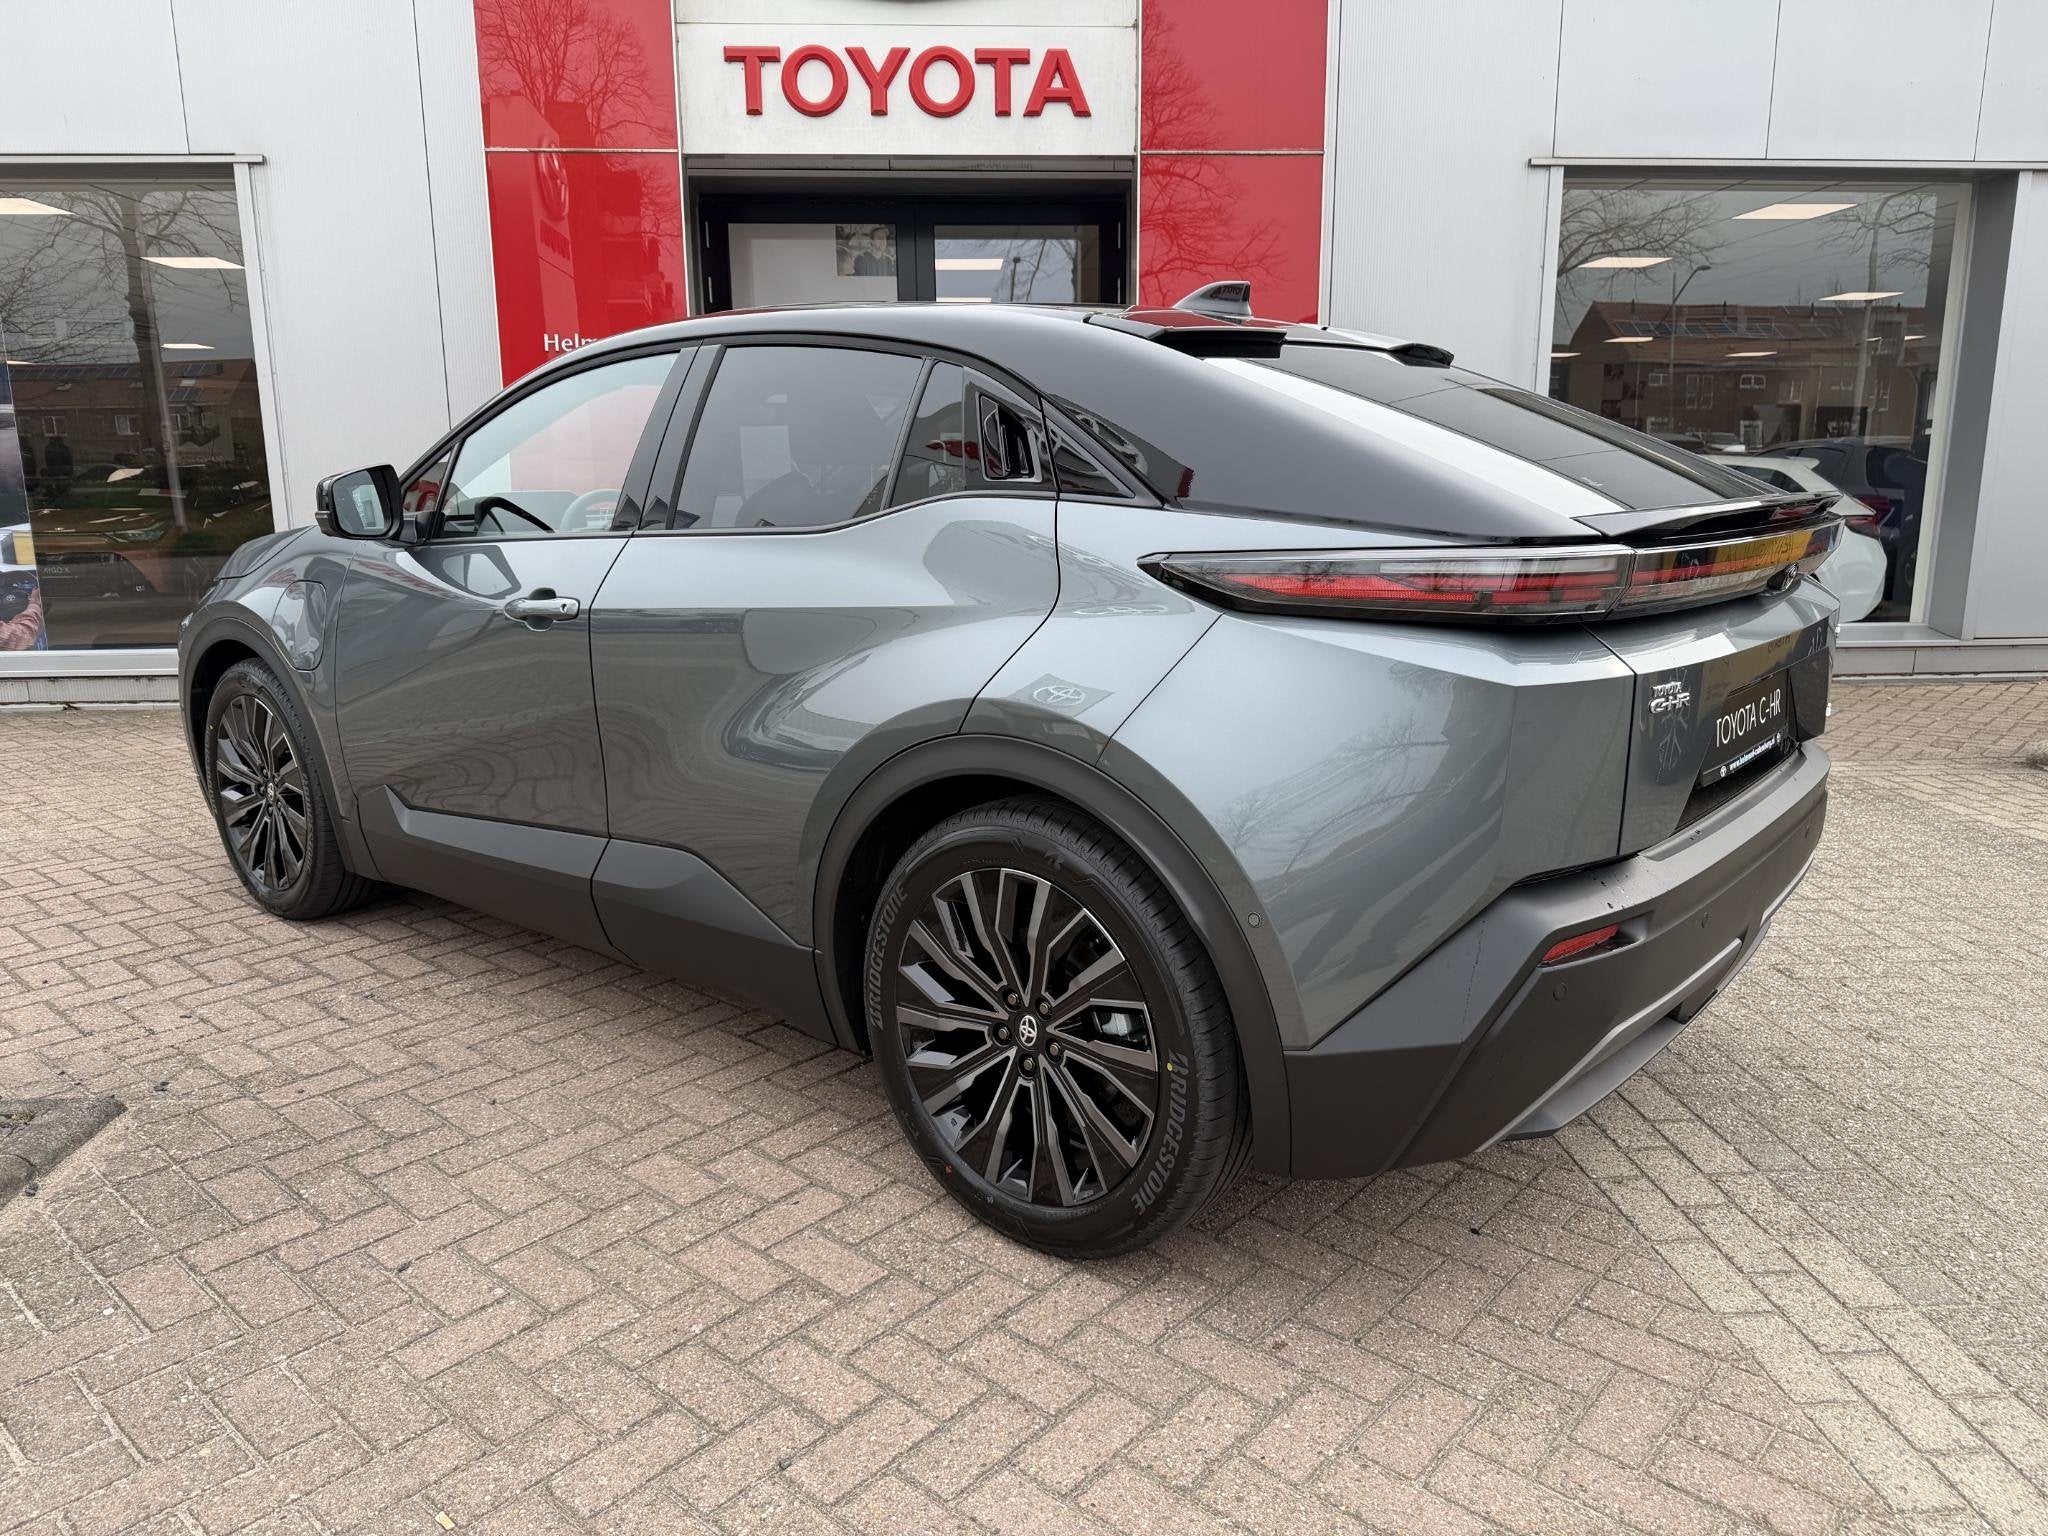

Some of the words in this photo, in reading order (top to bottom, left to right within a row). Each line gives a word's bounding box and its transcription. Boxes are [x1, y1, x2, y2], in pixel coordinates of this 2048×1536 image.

[723, 44, 1091, 118] TOYOTA
[543, 333, 598, 352] Hel
[1652, 681, 1682, 698] TOYOTA
[1716, 702, 1757, 748] TOYOTA
[1759, 688, 1781, 724] C-HR
[868, 883, 909, 1032] BRIDGESTONE
[1130, 1048, 1190, 1217] BRIDGESTONE
